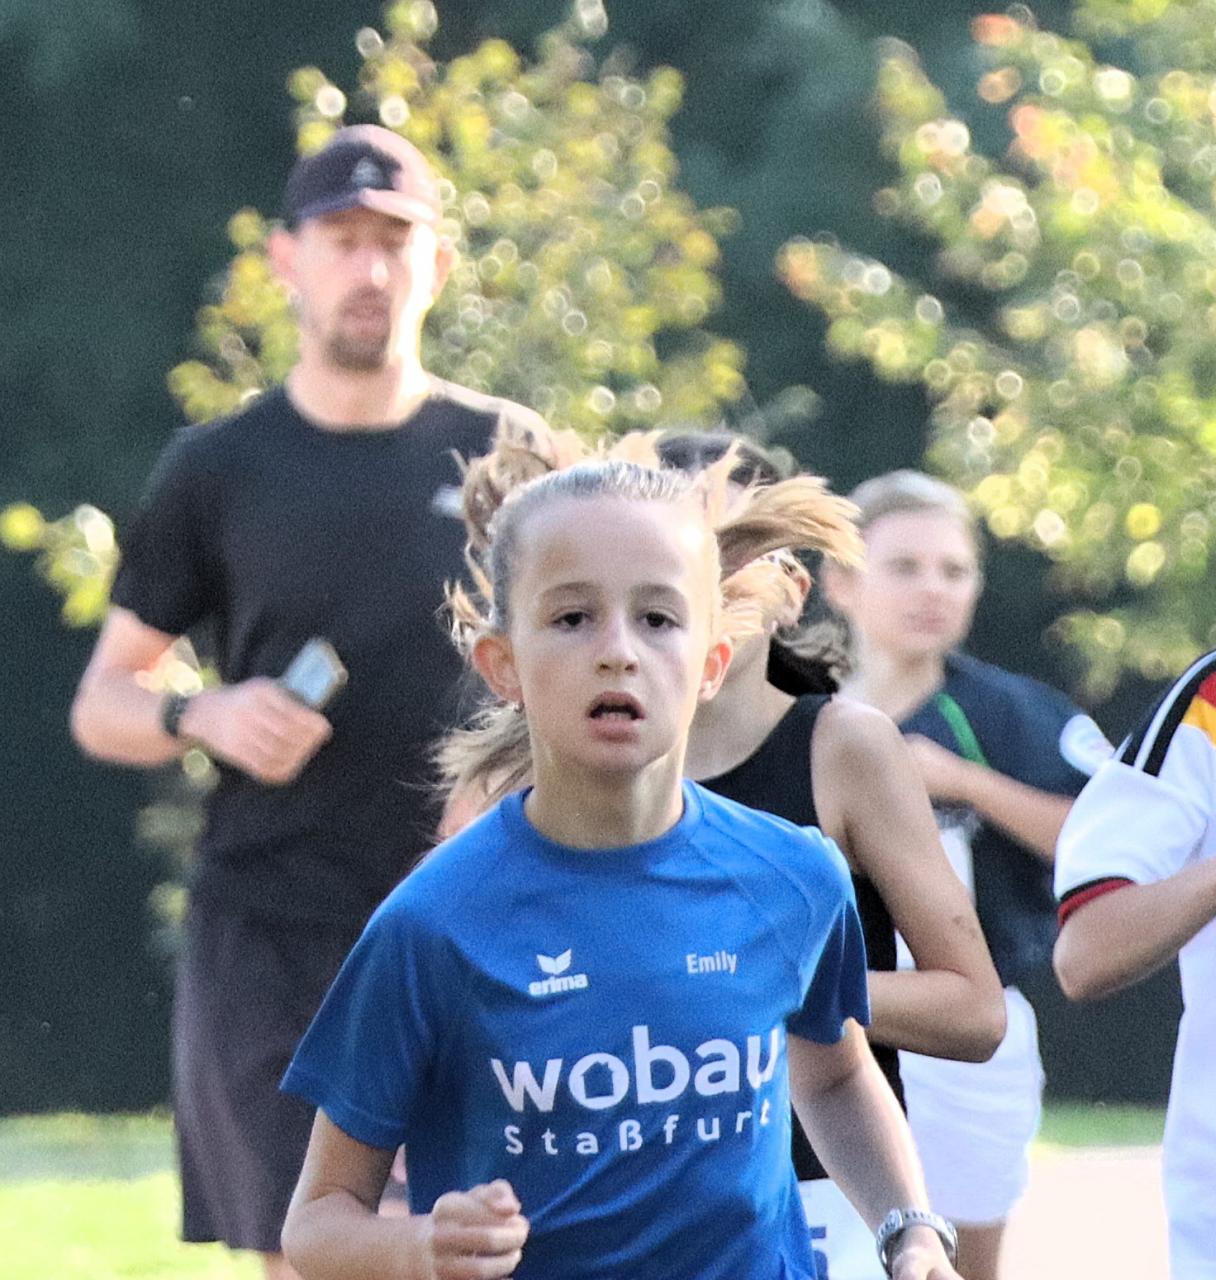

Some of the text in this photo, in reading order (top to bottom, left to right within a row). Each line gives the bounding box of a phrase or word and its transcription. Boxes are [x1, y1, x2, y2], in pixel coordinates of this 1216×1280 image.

[686, 950, 738, 975] Emily
[528, 973, 588, 996] erima
[490, 1024, 780, 1114] wobau
[503, 1099, 771, 1155] Staßfurt
